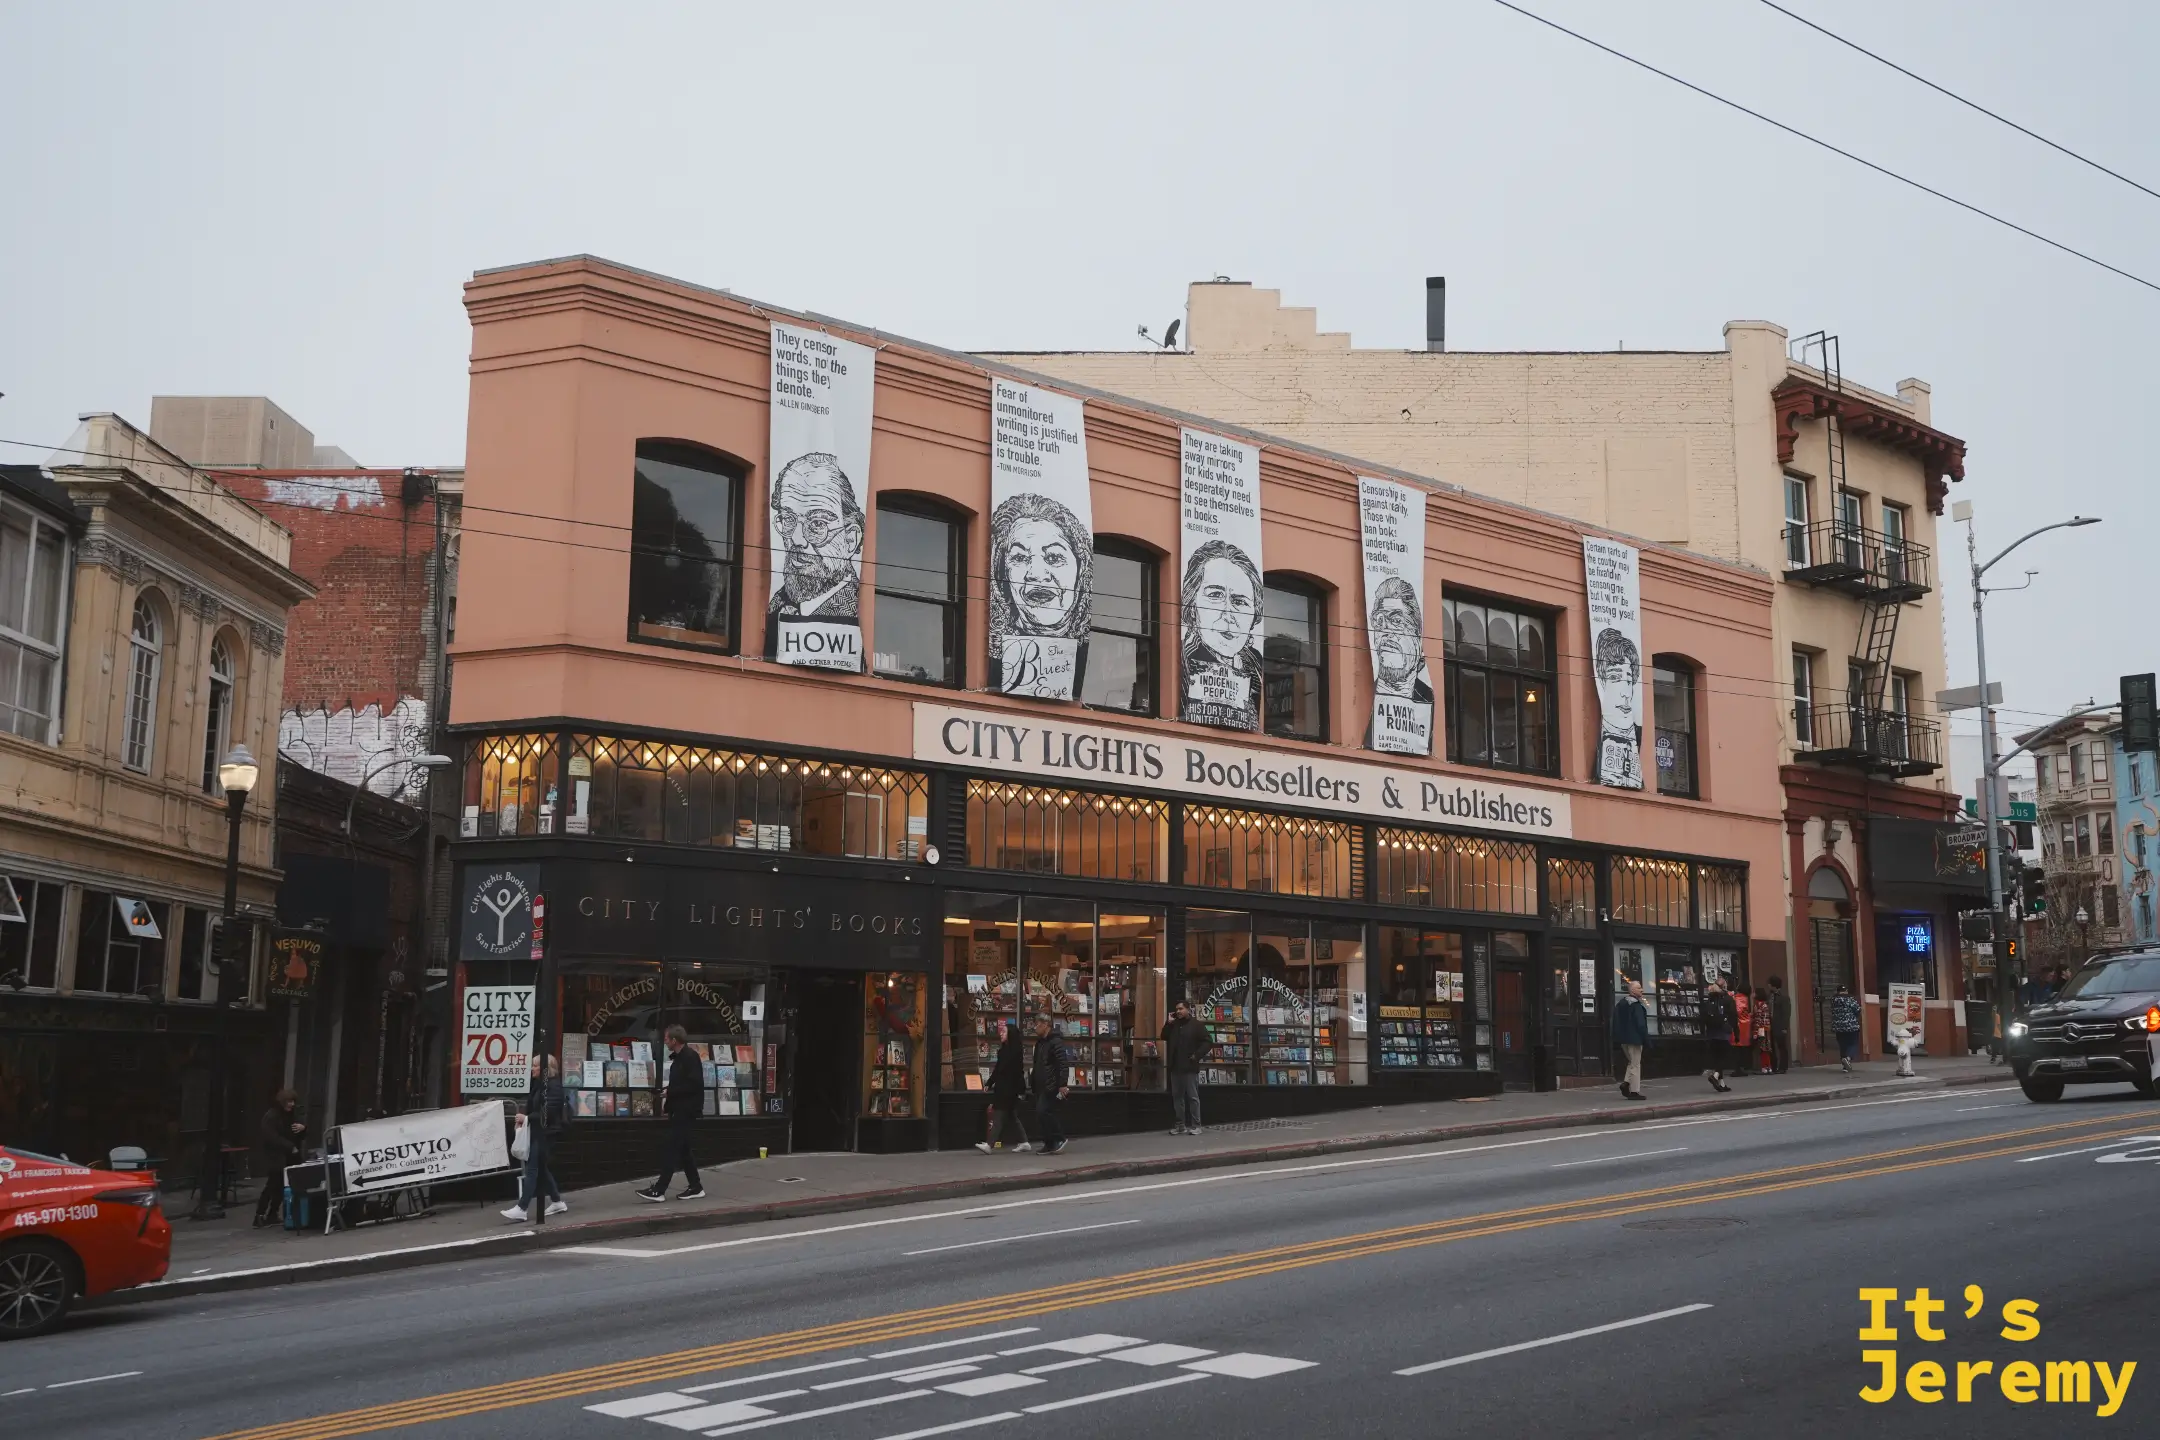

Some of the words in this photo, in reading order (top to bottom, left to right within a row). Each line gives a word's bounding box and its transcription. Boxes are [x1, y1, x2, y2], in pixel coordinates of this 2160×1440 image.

[776, 329, 800, 350] They
[804, 339, 837, 356] censor
[776, 362, 809, 383] things
[815, 357, 829, 369] no
[830, 360, 847, 376] the
[776, 379, 815, 399] denote.
[996, 383, 1016, 400] Fear
[1019, 391, 1028, 403] of
[800, 402, 830, 416] GINSBERG
[996, 402, 1054, 425] unmonitored
[996, 416, 1028, 437] writing
[1030, 422, 1039, 436] is
[1041, 424, 1079, 445] justified
[996, 429, 1035, 450] because
[1037, 439, 1060, 454] truth
[1184, 433, 1203, 452] They
[1204, 441, 1218, 453] are
[1219, 443, 1243, 463] taking
[996, 444, 1005, 458] is
[1007, 448, 1043, 467] trouble.
[1184, 451, 1205, 467] away
[1207, 455, 1236, 472] mirrors
[1184, 462, 1196, 476] for
[1198, 466, 1214, 480] kids
[1216, 471, 1233, 485] who
[1234, 477, 1244, 488] so
[1184, 477, 1230, 501] desperately
[1232, 489, 1251, 504] need
[1400, 490, 1407, 502] is
[1184, 492, 1192, 504] to
[1194, 495, 1208, 508] see
[1209, 497, 1255, 518] themselves
[1362, 497, 1389, 511] against
[1184, 505, 1192, 519] in
[1194, 507, 1221, 524] books.
[1363, 508, 1384, 523] Those
[1364, 522, 1377, 534] ban
[785, 631, 857, 655] HOWL
[1048, 645, 1064, 656] The
[1002, 639, 1071, 692] Bluest
[1219, 667, 1229, 678] AN
[1189, 703, 1222, 716] HISTORY
[1226, 708, 1234, 718] OF
[1237, 711, 1248, 722] THE
[1190, 714, 1220, 725] UNITED
[1386, 717, 1425, 738] RUNNING
[941, 717, 1030, 763] CITY
[1041, 729, 1164, 780] LIGHTS
[1185, 748, 1360, 804] Booksellers
[1382, 776, 1404, 810] &
[1420, 781, 1553, 828] Publishers
[1949, 831, 1986, 845] BROADWAY
[470, 892, 482, 914] City
[479, 873, 503, 894] Lights
[505, 871, 531, 912] Bookstore
[578, 896, 660, 922] CITY
[831, 913, 922, 936] BOOKS
[1906, 936, 1915, 944] BY
[1908, 927, 1925, 935] PIZZA
[275, 939, 321, 954] VESUVIO
[475, 932, 489, 949] San
[490, 931, 526, 954] Francisco
[1908, 943, 1925, 952] SLICE
[2009, 941, 2016, 955] 2
[466, 991, 532, 1013] CITY
[587, 1001, 613, 1037] CITY
[610, 977, 656, 1009] LIGHTS
[677, 977, 742, 1036] BOOKSTORE
[1203, 992, 1218, 1018] CITY
[1216, 975, 1248, 996] LIGHTS
[1261, 976, 1305, 1023] BOOKSTORE
[465, 1013, 531, 1029] LIGHTS
[465, 1067, 527, 1075] ANNIVERSARY
[465, 1077, 525, 1088] 1953-2023
[351, 1137, 452, 1166] VESUVIO
[8, 1170, 22, 1179] SAN
[25, 1168, 63, 1178] FRANCISCO
[349, 1163, 383, 1177] entrance
[385, 1161, 398, 1170] On
[399, 1155, 439, 1168] Columbus
[441, 1152, 457, 1161] Ave
[427, 1164, 448, 1175] 21+
[15, 1203, 99, 1227] 415-970-1300
